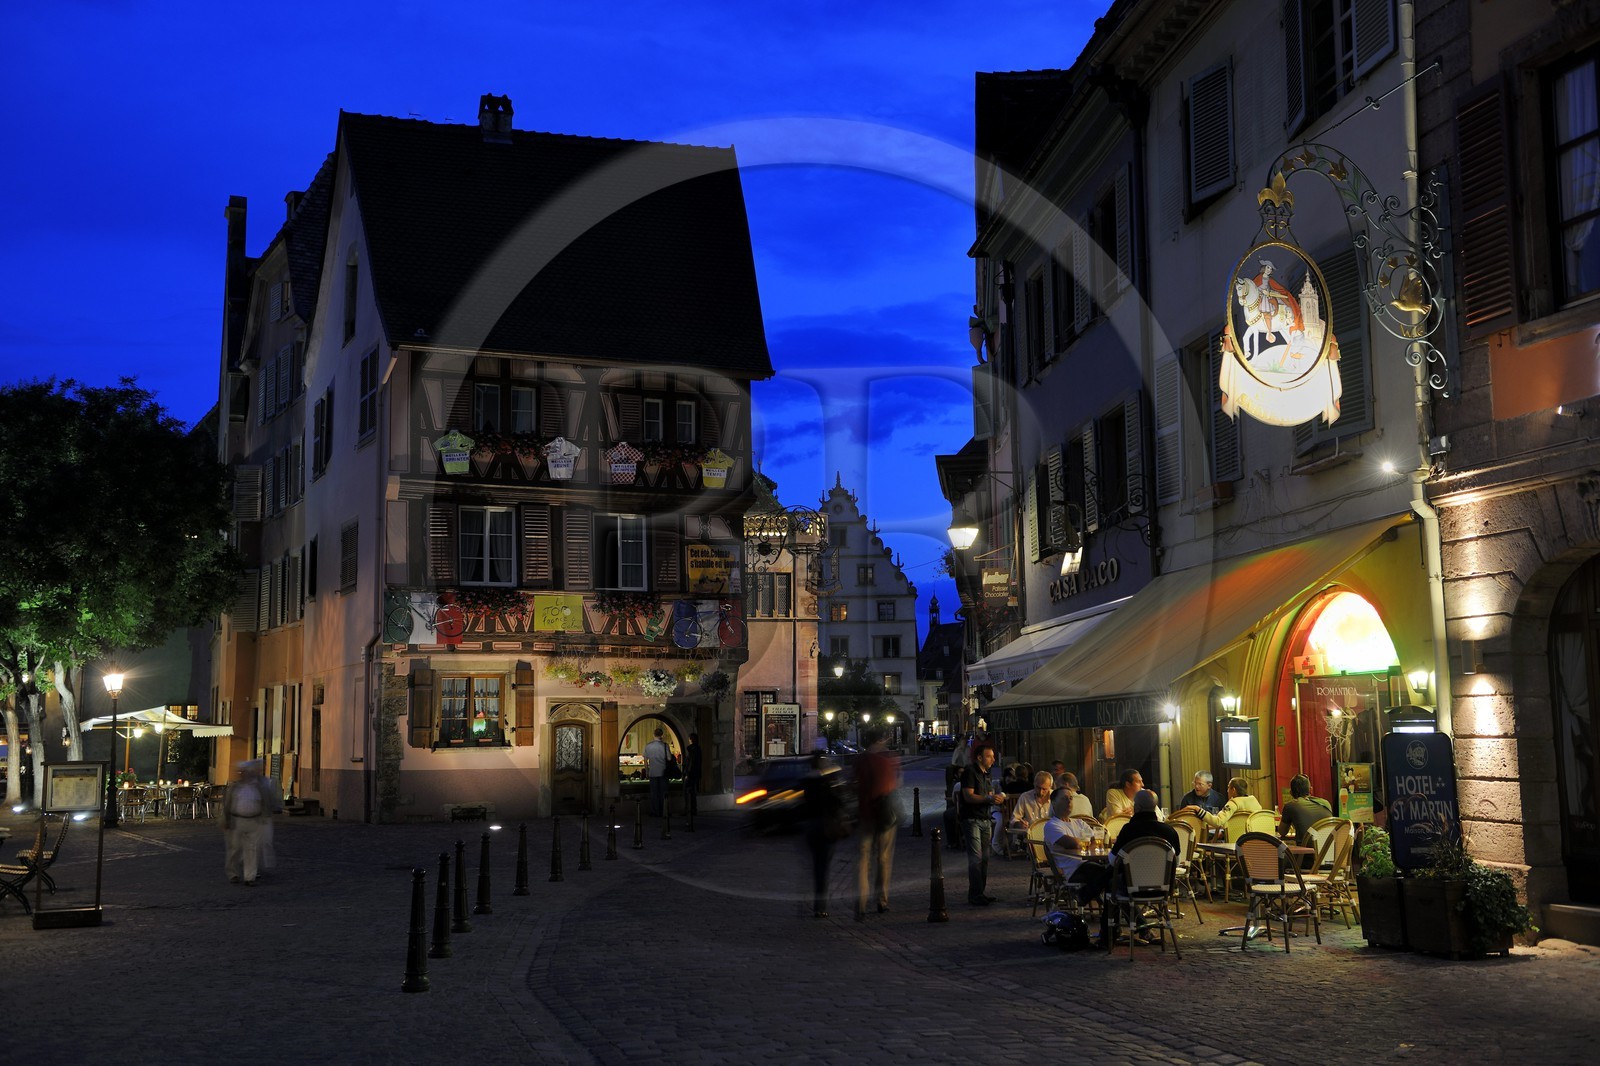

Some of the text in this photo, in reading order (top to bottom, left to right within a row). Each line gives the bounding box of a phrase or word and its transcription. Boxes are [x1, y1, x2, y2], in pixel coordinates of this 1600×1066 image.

[690, 548, 700, 558] Cet
[1049, 557, 1118, 602] CASA PACO
[677, 647, 735, 661] FRANCE
[1316, 687, 1357, 696] ROMANTICA
[990, 709, 1020, 730] PIZZERIA
[1031, 704, 1081, 729] ROMANTICA
[1395, 775, 1437, 795] HOTEL
[1393, 800, 1454, 821] ST MARTIN
